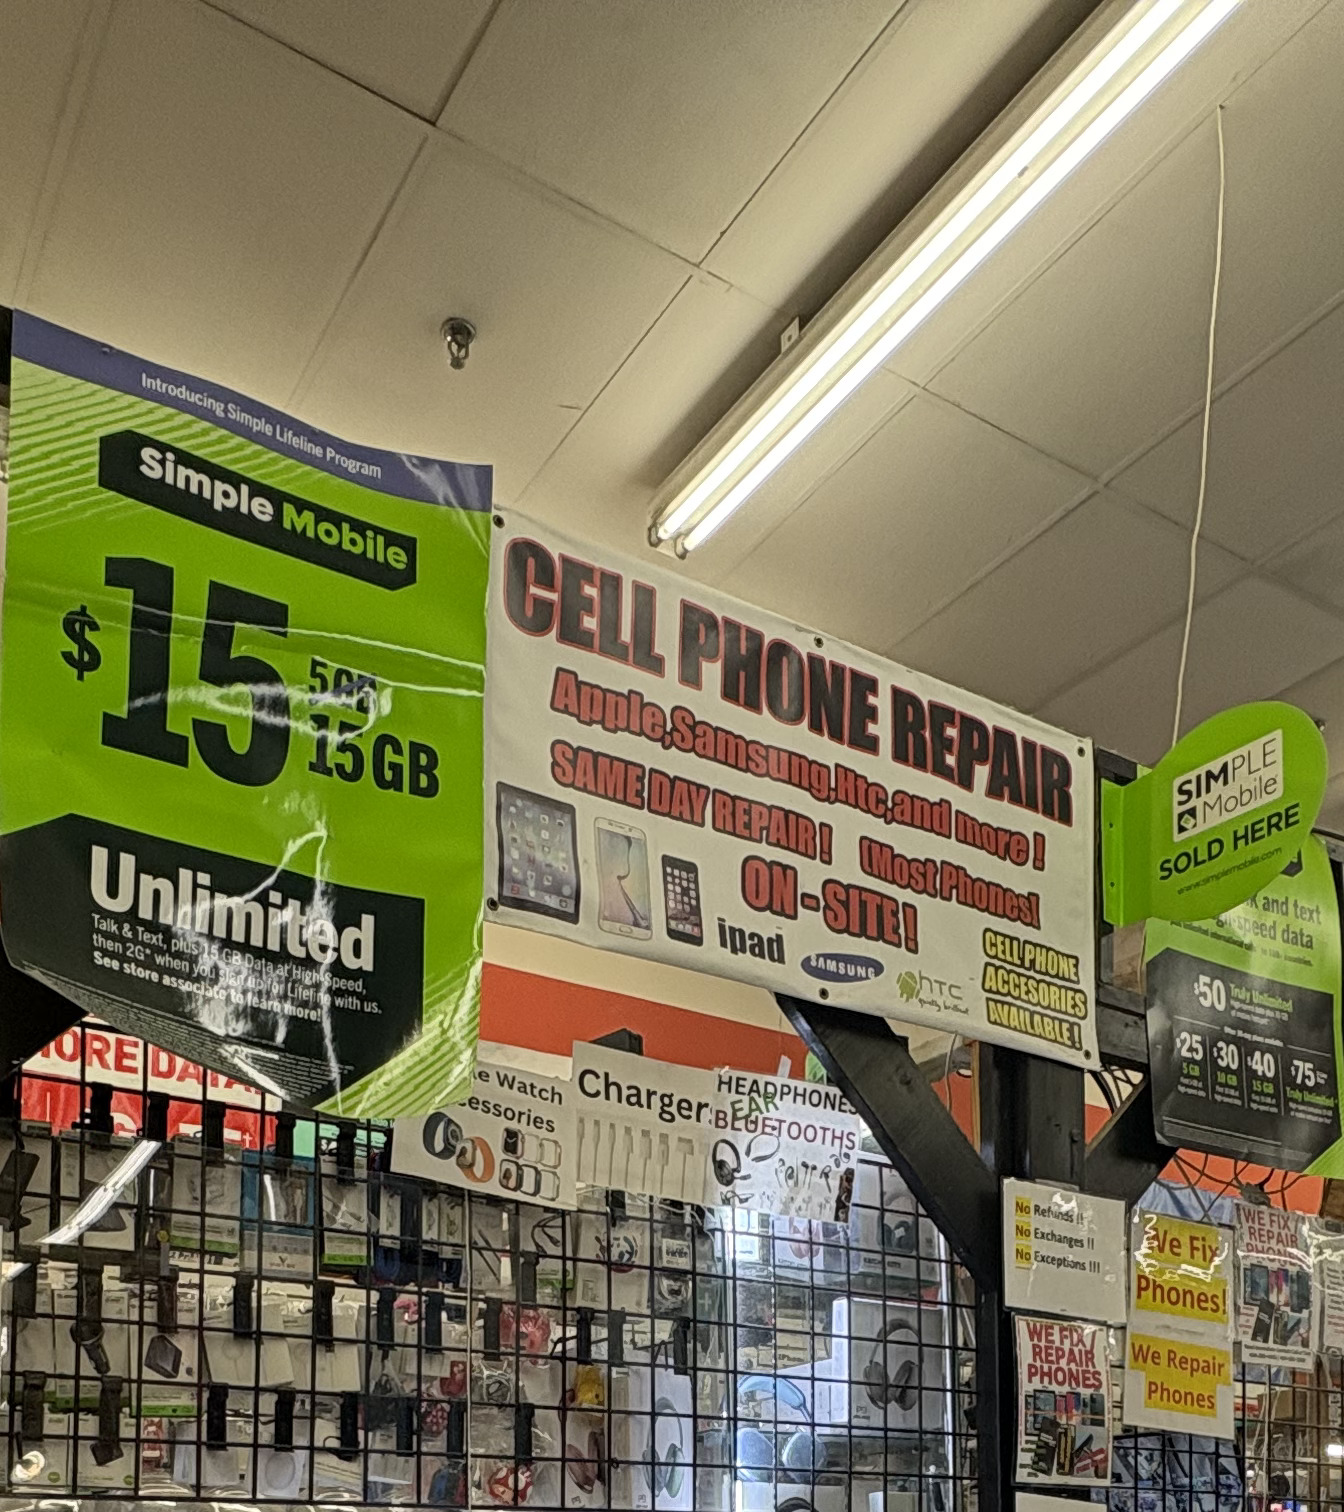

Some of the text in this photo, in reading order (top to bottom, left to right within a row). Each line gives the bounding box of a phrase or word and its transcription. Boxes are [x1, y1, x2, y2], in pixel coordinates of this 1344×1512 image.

[141, 372, 383, 481] Introducing Simple Lifeline Program
[138, 445, 410, 571] Simple Mobile
[502, 536, 1074, 828] CELL PHONE REPAIR
[550, 738, 711, 830] SAME DAY
[1177, 736, 1278, 807] SIMPLE
[1202, 773, 1278, 824] Mobile
[1159, 801, 1301, 882] SOLD HERE
[89, 844, 376, 973] Unlimited
[1262, 893, 1323, 926] and text
[91, 912, 198, 956] Talk Text, plus
[717, 917, 786, 966] ipad
[1281, 923, 1315, 951] data
[92, 933, 362, 1013] then when Lifeline with
[808, 954, 878, 982] SAMSUNG
[982, 928, 1081, 986] CELL PHONE
[93, 951, 323, 1023] See store associate more!
[981, 961, 1088, 1021] ACCESORIES
[495, 1069, 563, 1106] Watch
[578, 1067, 713, 1126] Charger
[1015, 1199, 1075, 1223] No Refunds
[1242, 1206, 1291, 1232] WE FIX
[1015, 1223, 1085, 1250] No Exchanges
[1247, 1226, 1298, 1249] REPAIR
[1015, 1247, 1087, 1272] No Exceptions
[1136, 1273, 1228, 1317] Phones!
[1026, 1321, 1055, 1344] WE
[1027, 1363, 1103, 1390] PHONES
[1031, 1343, 1097, 1369] REPAIR
[1130, 1341, 1162, 1366] We
[1167, 1348, 1225, 1378] Repair
[1146, 1380, 1216, 1410] Phones
